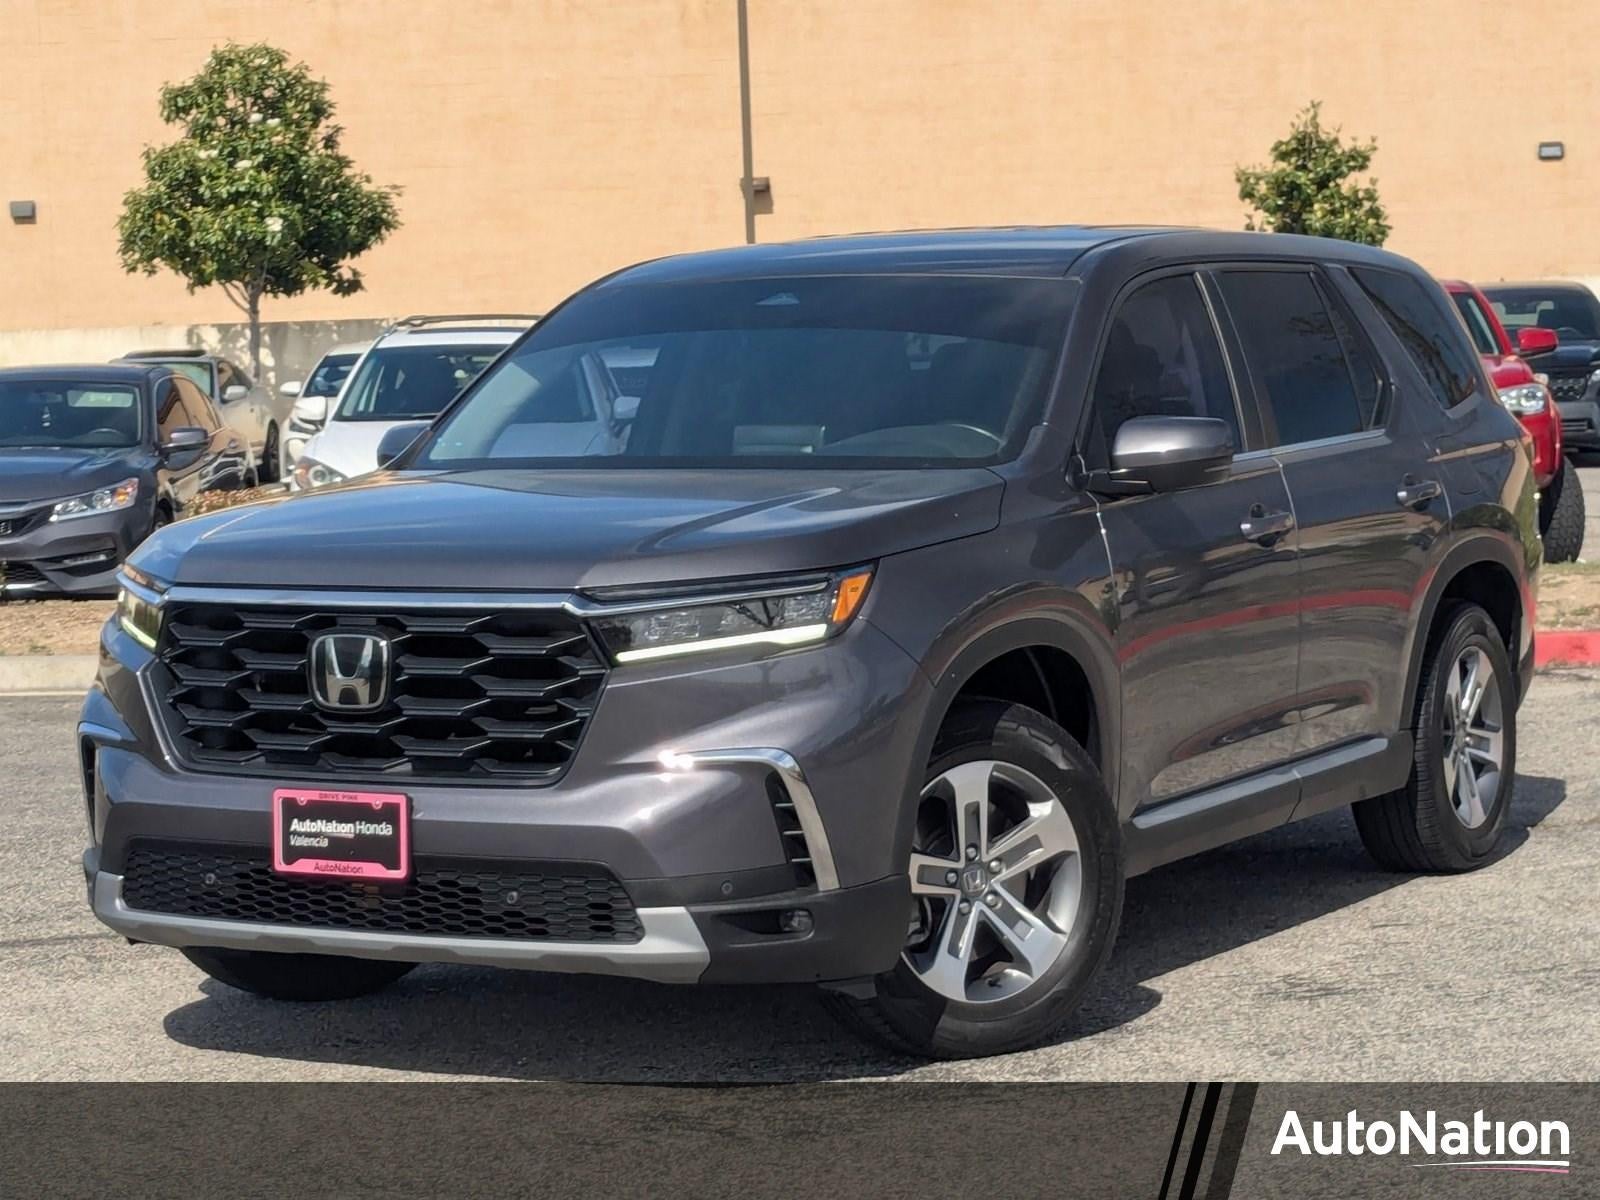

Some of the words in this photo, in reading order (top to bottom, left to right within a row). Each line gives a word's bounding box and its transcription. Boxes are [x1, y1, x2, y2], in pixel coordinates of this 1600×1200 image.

[319, 792, 340, 800] DRIVE
[290, 818, 355, 833] AutoNation
[355, 821, 393, 836] Honda
[289, 834, 329, 848] Valencia
[314, 862, 364, 874] AutoNation
